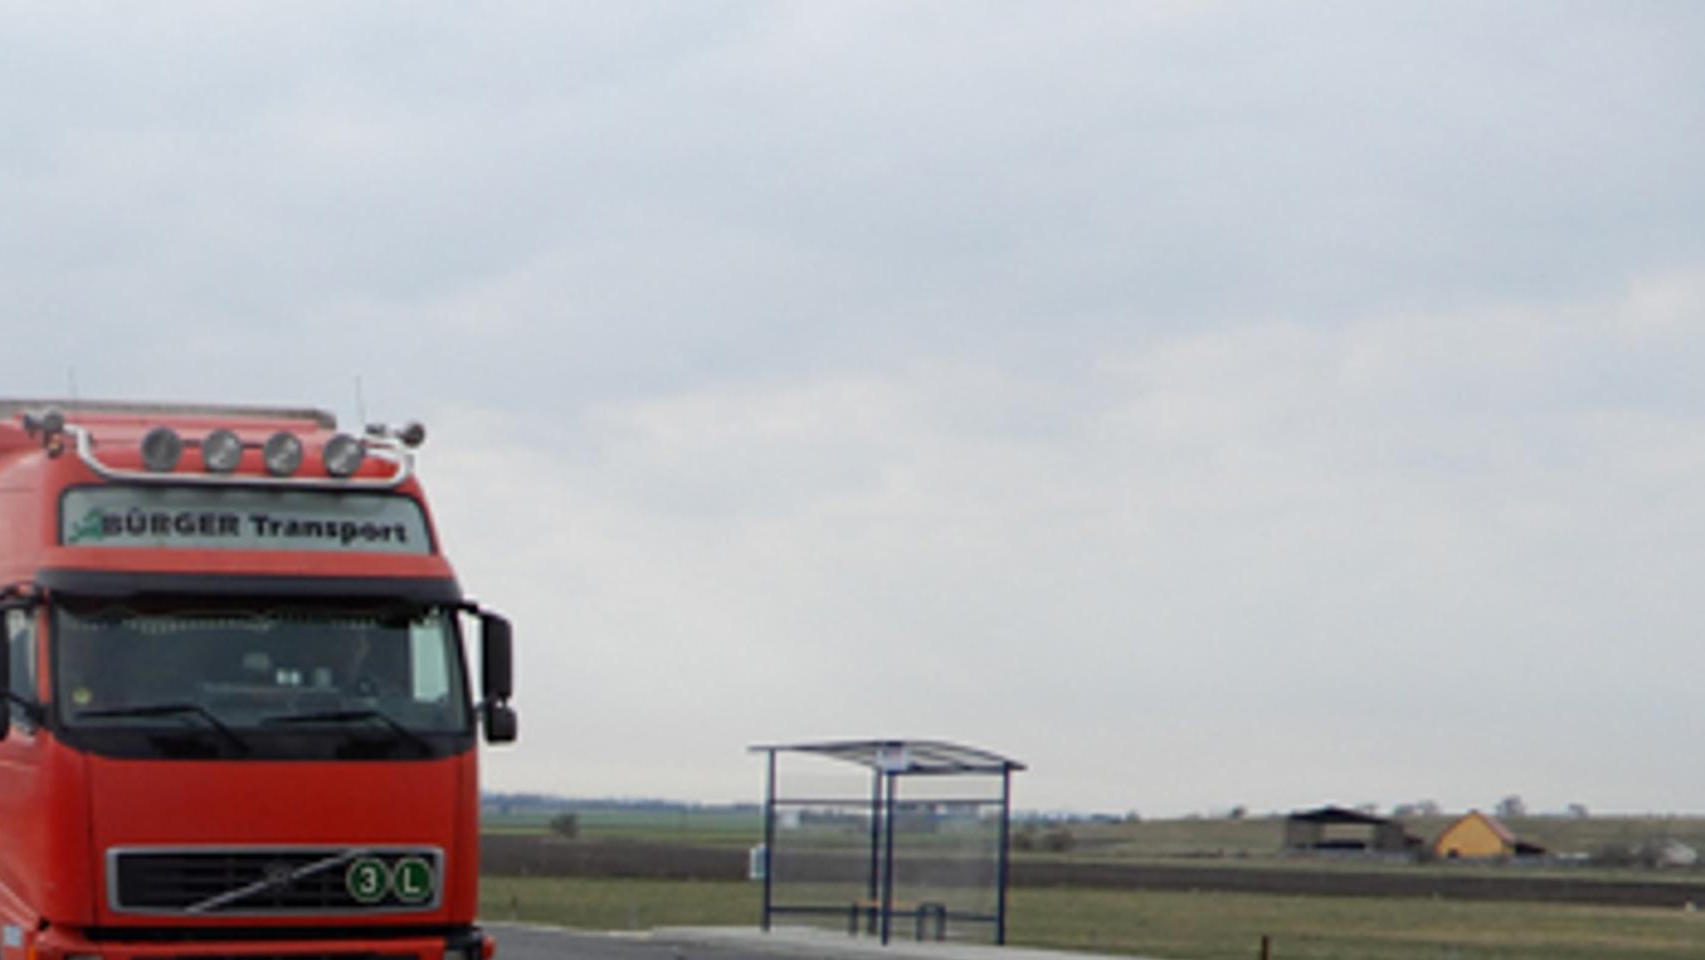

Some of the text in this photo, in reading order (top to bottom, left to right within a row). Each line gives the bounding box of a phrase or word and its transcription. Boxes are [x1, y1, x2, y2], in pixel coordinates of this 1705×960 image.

[102, 508, 409, 547] BÜRGER Transport
[360, 868, 378, 894] 3
[403, 868, 421, 895] L
